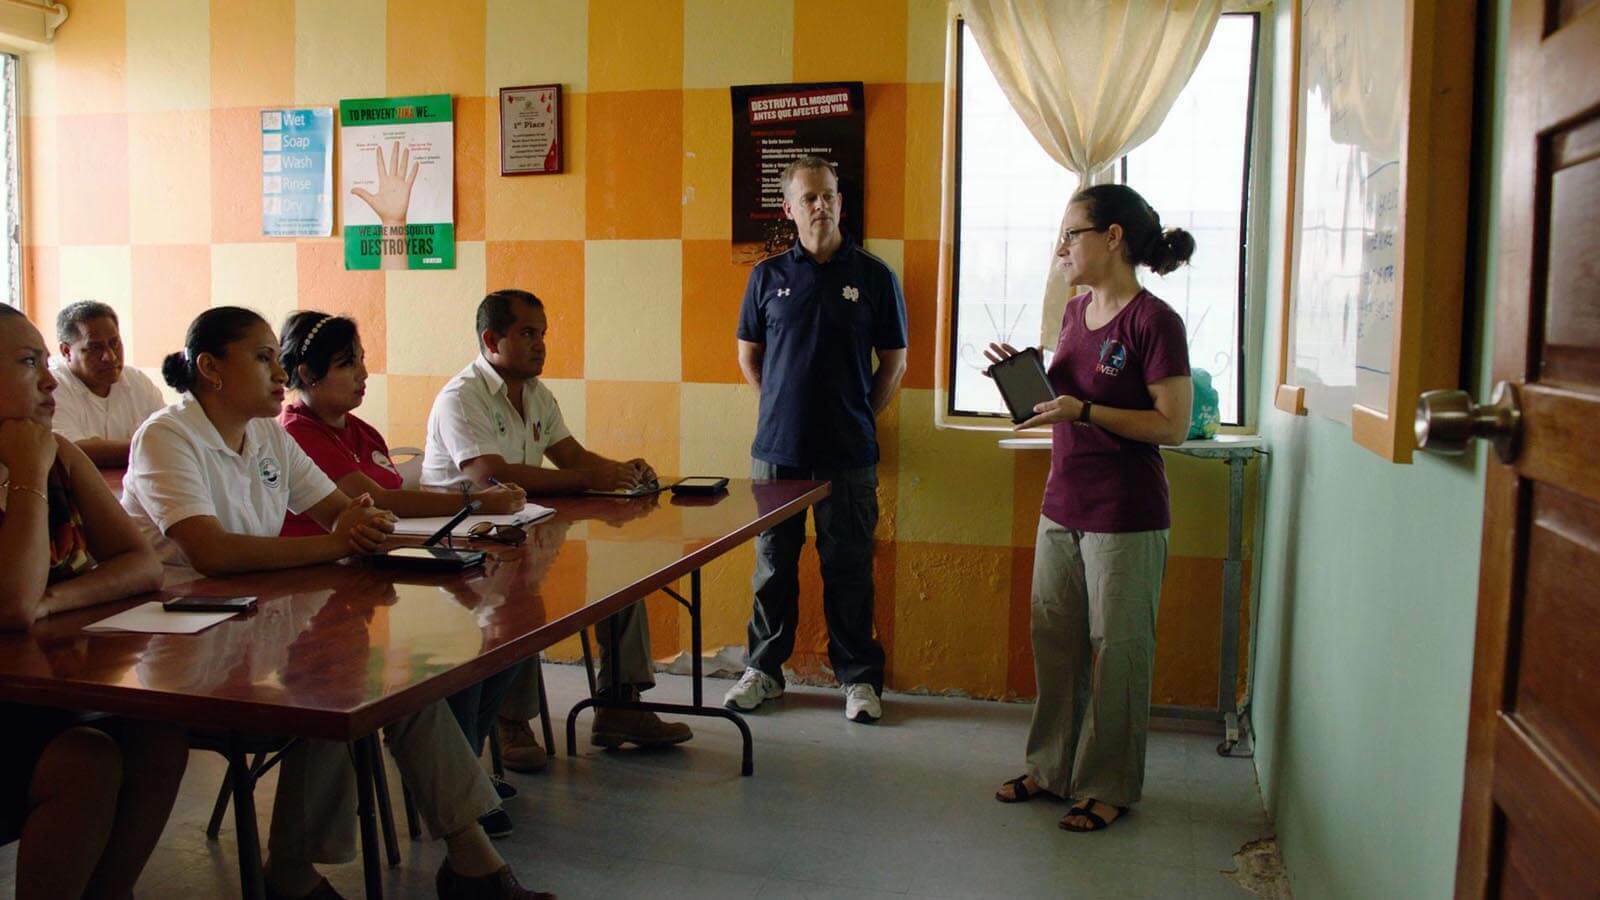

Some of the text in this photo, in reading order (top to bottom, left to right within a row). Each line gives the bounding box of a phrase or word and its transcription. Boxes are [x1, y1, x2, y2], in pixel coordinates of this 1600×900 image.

[751, 93, 848, 112] DESTRUYA EL MOSQUITO
[283, 112, 305, 126] Wet
[349, 109, 360, 121] TO
[361, 107, 395, 121] PREVENT
[753, 103, 848, 121] ANTES QUE AFECTE SU VIDA
[524, 121, 545, 129] Place
[282, 135, 310, 150] Soap
[282, 155, 312, 169] Wash
[282, 177, 311, 190] Rinse
[359, 224, 435, 237] WE ARE MOSQUITO
[361, 238, 434, 256] DESTROYERS
